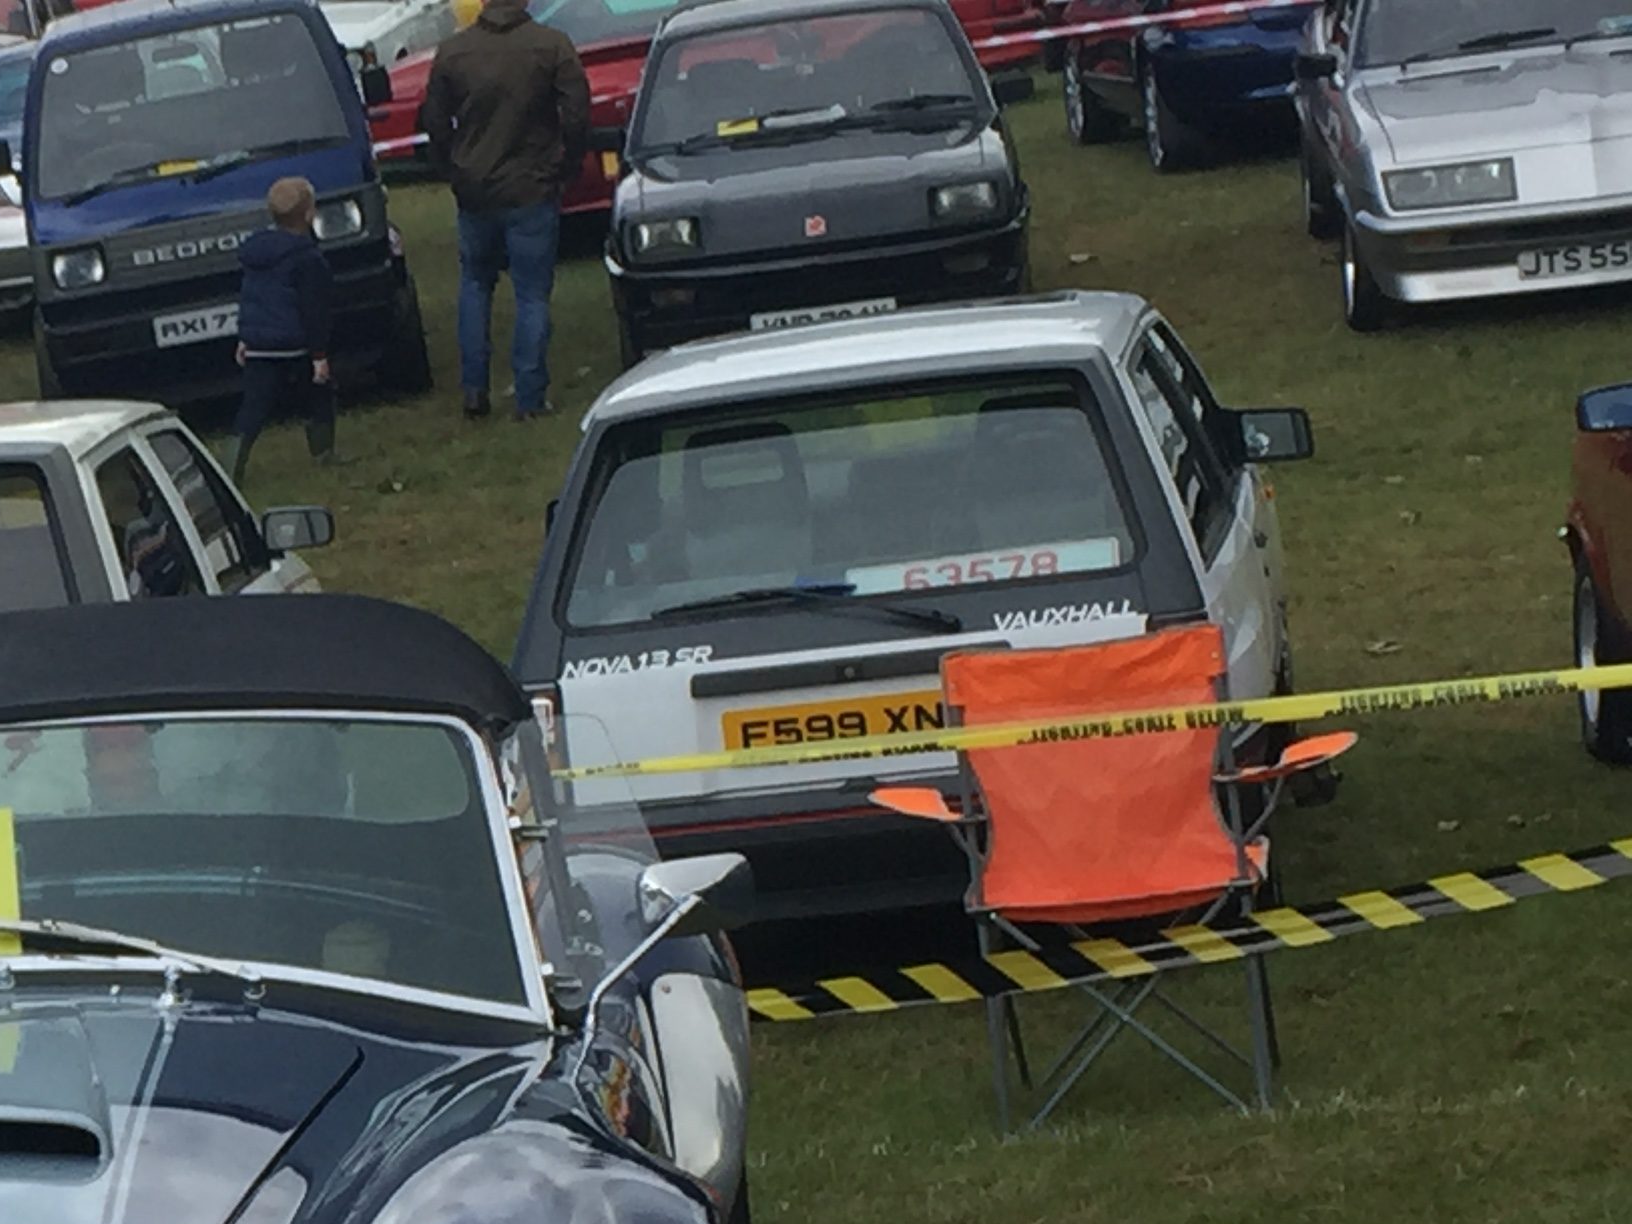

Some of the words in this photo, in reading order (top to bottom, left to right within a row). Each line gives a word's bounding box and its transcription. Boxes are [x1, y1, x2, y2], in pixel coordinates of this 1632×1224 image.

[132, 224, 278, 266] BEDFO
[1523, 247, 1582, 275] JTS
[1589, 242, 1632, 268] 55
[902, 549, 1059, 590] 63578
[993, 598, 1138, 632] VAUXHALL
[561, 652, 634, 681] NOVA
[741, 711, 868, 749] F599
